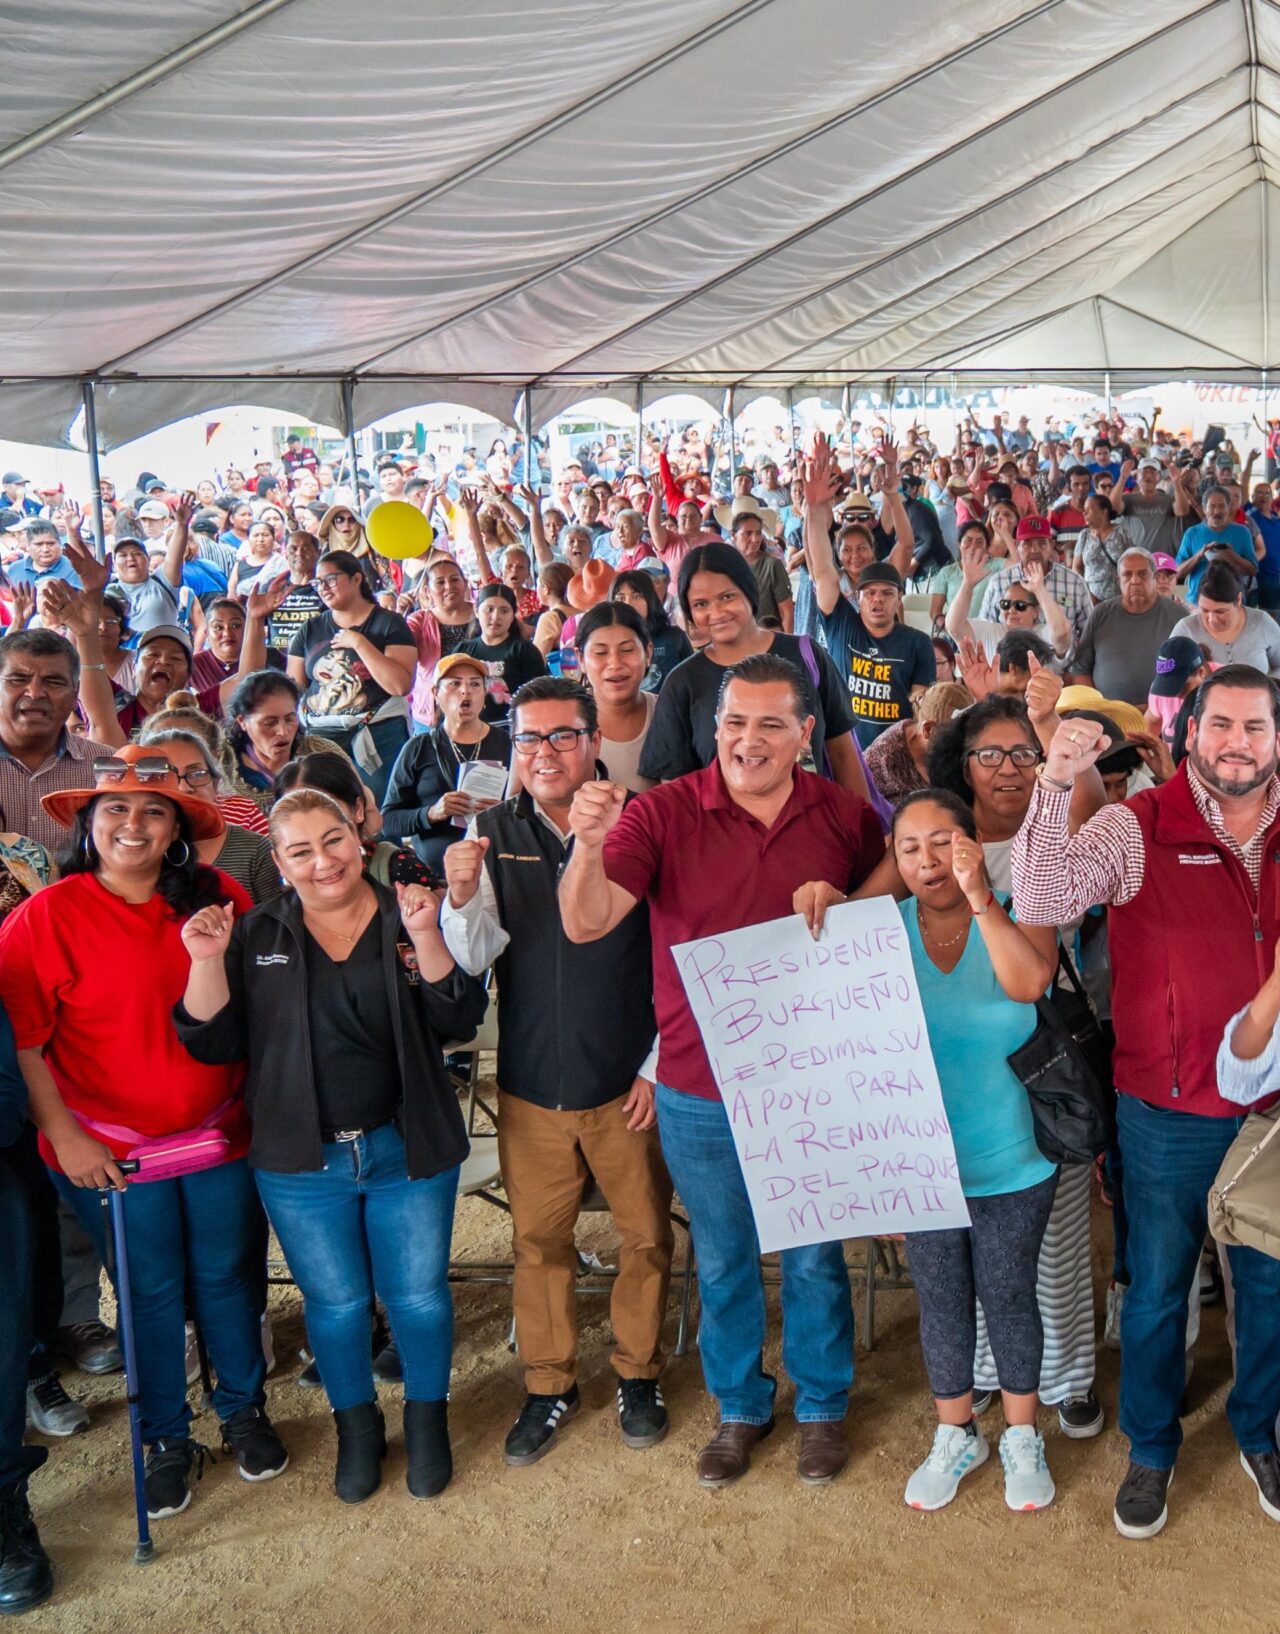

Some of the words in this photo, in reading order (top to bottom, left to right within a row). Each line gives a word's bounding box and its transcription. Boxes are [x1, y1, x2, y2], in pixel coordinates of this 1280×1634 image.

[848, 675, 892, 700] BETTER
[852, 656, 892, 682] WE'RE
[851, 695, 900, 719] GETHER
[683, 925, 901, 1007] PRESIDENTE
[710, 970, 911, 1046] BURGUEÑO
[715, 1056, 758, 1086] LE
[883, 1023, 922, 1054] SU
[732, 1086, 833, 1129] APOYO
[845, 1067, 926, 1104] PARA
[743, 1135, 784, 1165] LA
[785, 1112, 952, 1160] RENOVACION
[760, 1168, 850, 1203] DEL
[855, 1152, 961, 1182] PARQUE
[785, 1187, 916, 1235] MORITA
[921, 1184, 952, 1213] II
